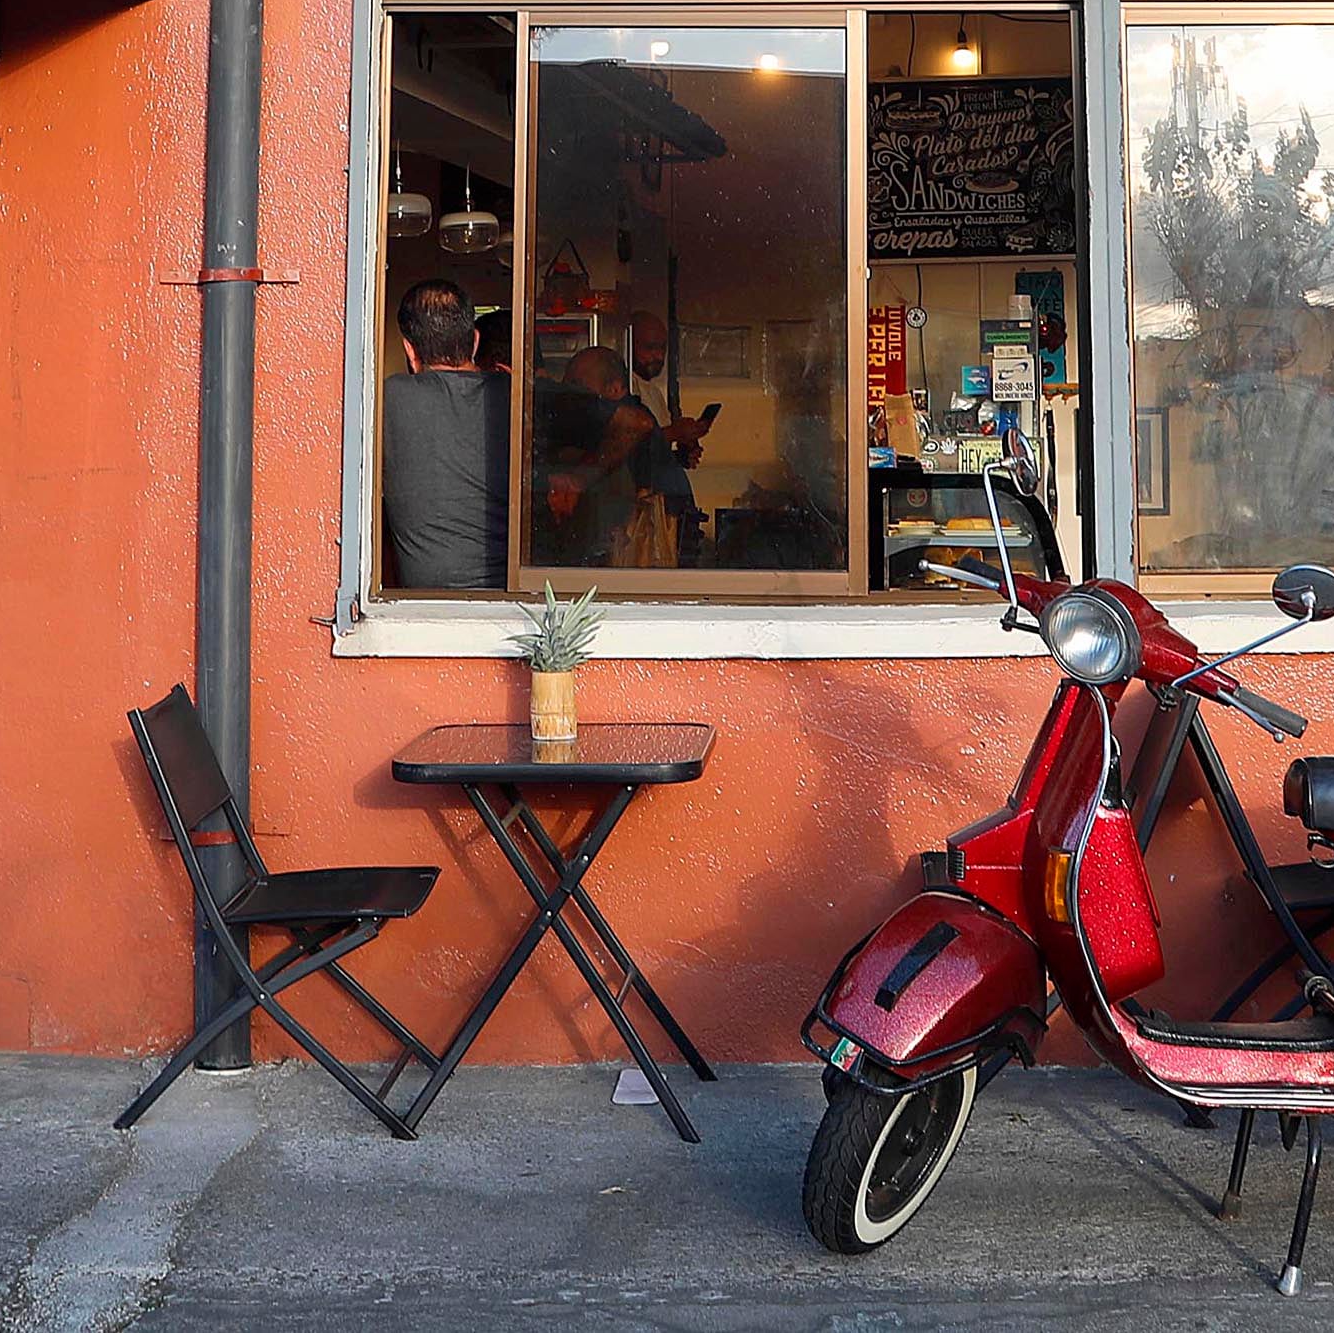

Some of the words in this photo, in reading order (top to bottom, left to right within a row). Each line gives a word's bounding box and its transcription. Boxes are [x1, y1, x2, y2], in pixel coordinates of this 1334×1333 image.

[913, 132, 964, 158] Plato
[970, 127, 1002, 150] del
[890, 160, 1026, 212] SANDWICHES
[894, 215, 953, 228] Ensaladas
[964, 214, 1030, 226] Quesadillas
[873, 229, 958, 257] crepas
[961, 448, 982, 472] HEY
